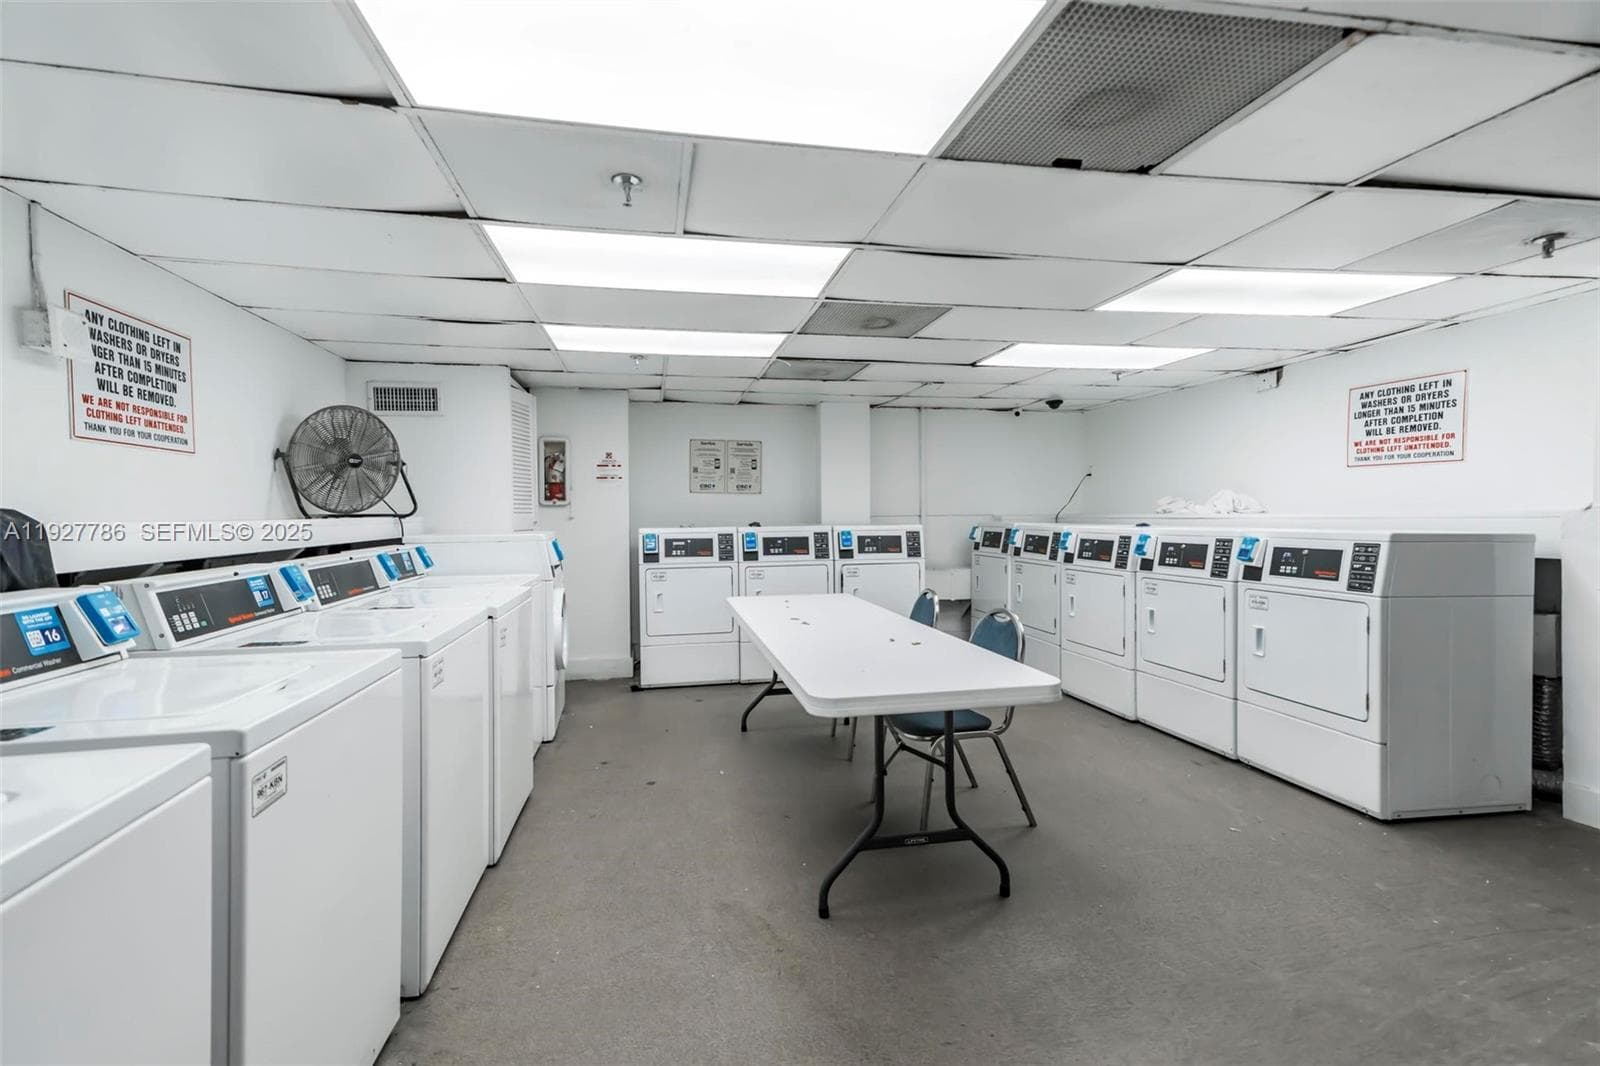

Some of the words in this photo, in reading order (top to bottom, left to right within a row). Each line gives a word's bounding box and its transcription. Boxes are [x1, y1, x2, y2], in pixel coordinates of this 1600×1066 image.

[85, 309, 104, 327] ANY
[108, 318, 150, 343] CLOTHING
[152, 334, 170, 350] LEFT
[173, 342, 181, 354] IN
[88, 327, 132, 352] WASHERS
[136, 343, 147, 356] OR
[150, 348, 180, 367] DRYERS
[91, 344, 114, 362] NGER
[117, 352, 141, 369] THAN
[144, 360, 152, 372] 15
[154, 364, 186, 382] MINUTES
[95, 362, 124, 380] AFTER
[127, 370, 177, 394] COMPLETION
[1360, 391, 1375, 400] ANY
[1377, 384, 1415, 398] CLOTHING
[1419, 380, 1439, 391] LEFT
[1443, 378, 1452, 387] IN
[96, 378, 119, 394] WILL
[122, 385, 133, 398] BE
[137, 388, 176, 408] REMOVED.
[1361, 397, 1398, 409] WASHERS
[1401, 395, 1412, 404] OR
[1415, 390, 1449, 402] DRYERS
[82, 394, 94, 405] WE
[98, 398, 112, 408] ARE
[116, 401, 129, 411] NOT
[132, 405, 174, 421] RESPONSIBLE
[177, 414, 188, 423] FOR
[1354, 408, 1380, 420] LONGER
[1384, 405, 1404, 416] THAN
[1407, 404, 1416, 413] 15
[1419, 399, 1457, 412] MINUTES
[1364, 417, 1388, 427] AFTER
[1391, 411, 1444, 424] COMPLETION
[86, 407, 123, 423] CLOTHING
[126, 415, 141, 426] LEFT
[144, 419, 185, 434] UNATTENDED.
[1366, 428, 1383, 437] WILL
[1386, 426, 1396, 435] BE
[1399, 422, 1442, 433] REMOVED.
[84, 422, 107, 432] THANK
[109, 426, 121, 435] YOU
[123, 428, 135, 437] FOR
[137, 431, 151, 440] YOUR
[154, 434, 188, 446] COOPERATION
[1394, 434, 1438, 444] RESPONSIBLE
[1404, 442, 1451, 451] UNATTENDED.
[44, 629, 61, 643] 16
